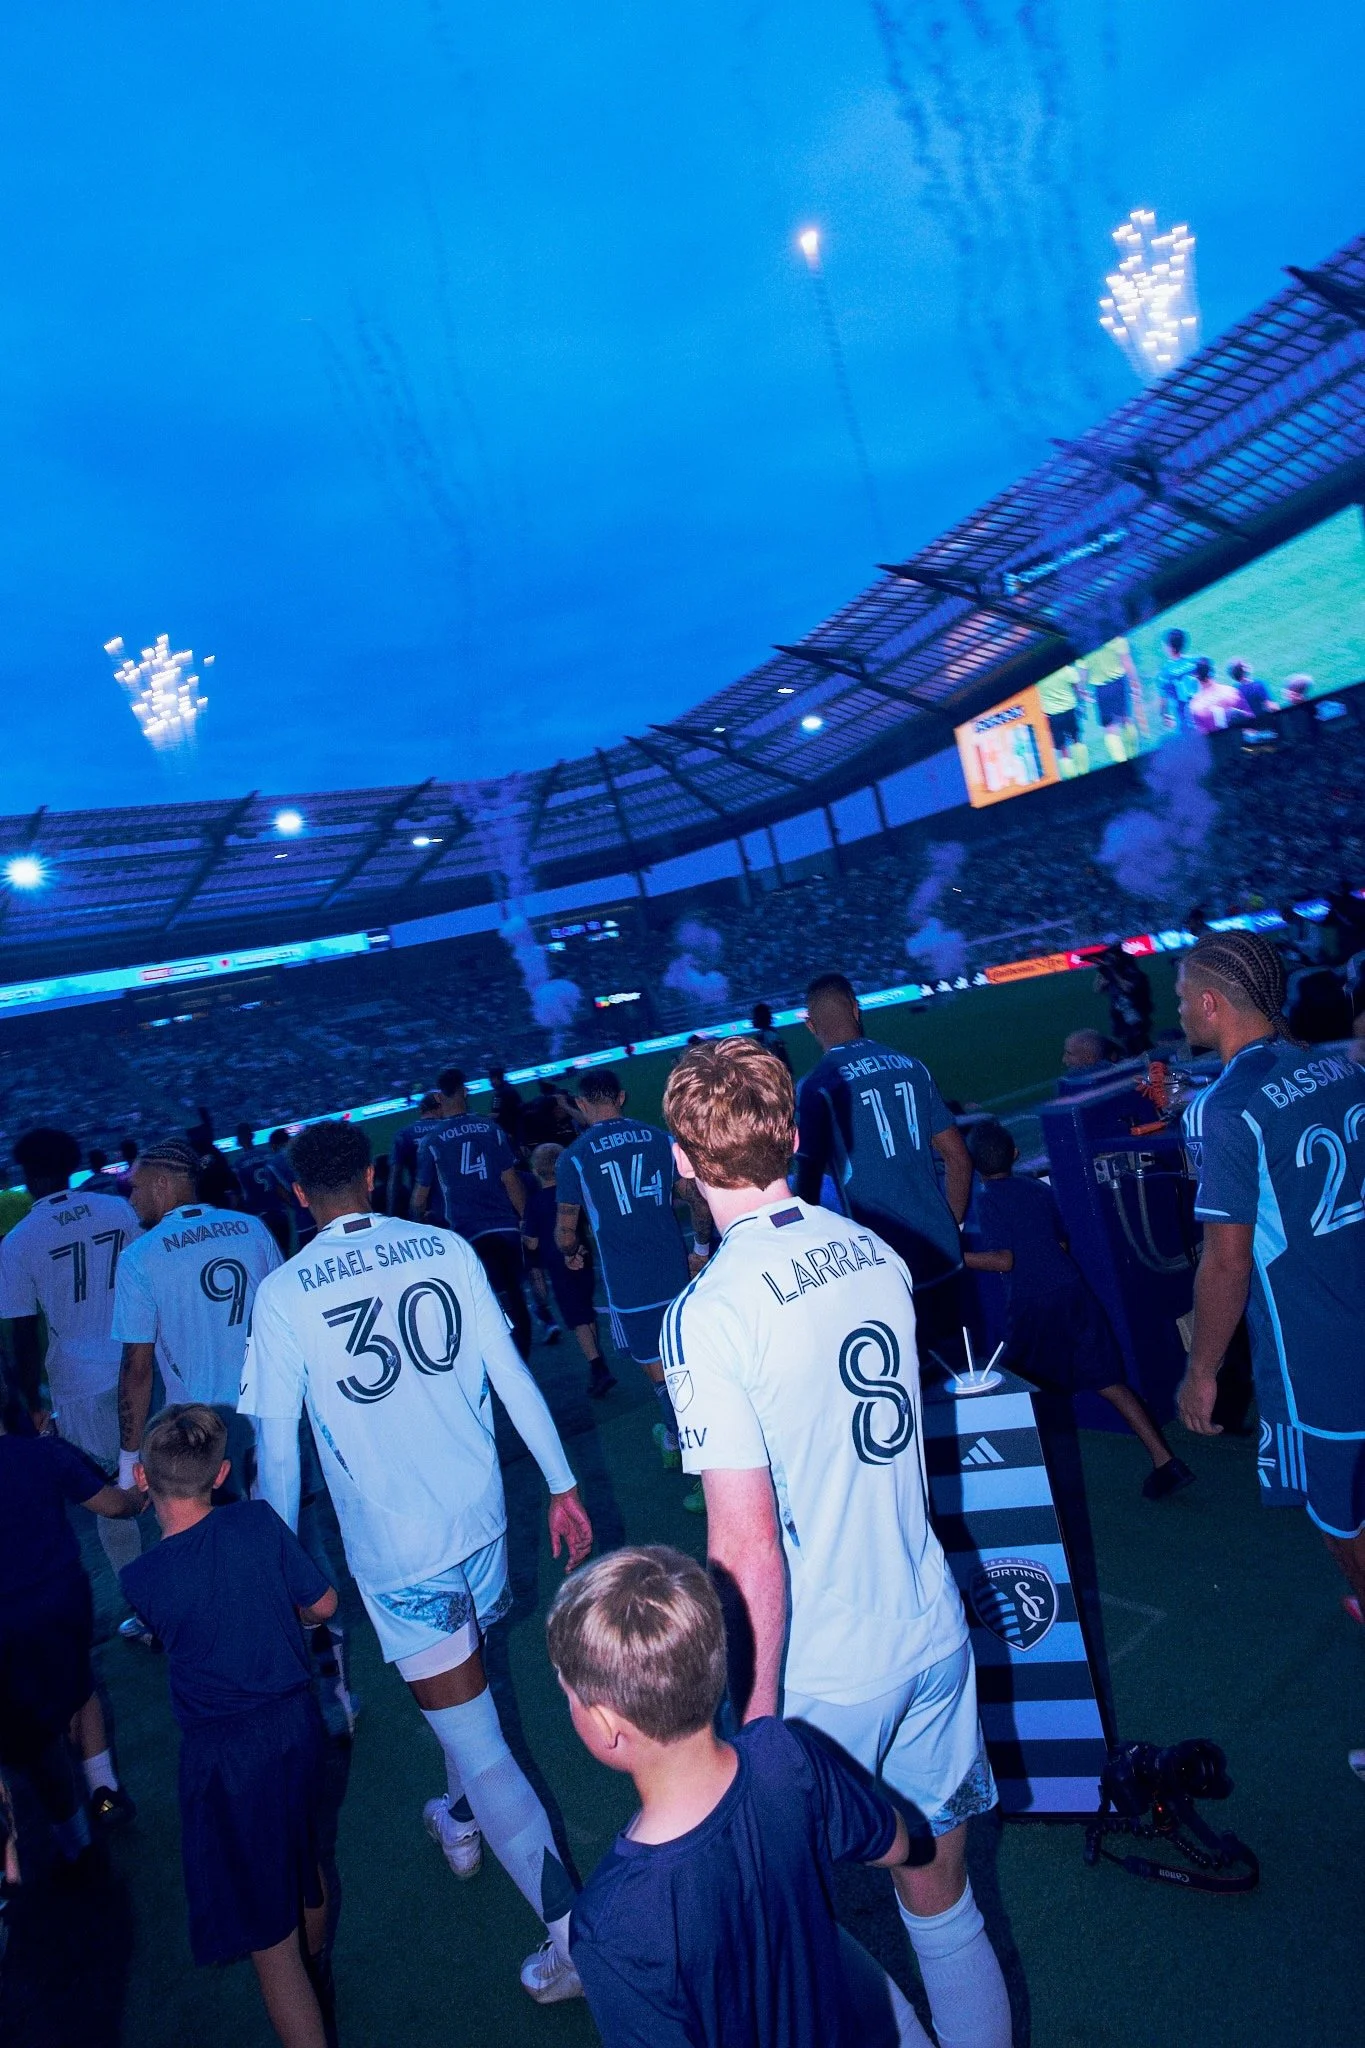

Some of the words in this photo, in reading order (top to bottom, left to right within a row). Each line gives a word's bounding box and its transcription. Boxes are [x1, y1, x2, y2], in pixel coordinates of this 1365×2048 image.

[839, 1054, 914, 1081] SHELTON
[590, 1129, 652, 1154] LEIBOLD
[860, 1081, 921, 1158] 11
[460, 1141, 488, 1180] 4
[600, 1153, 663, 1216] 14
[52, 1204, 92, 1226] YAPI
[162, 1220, 249, 1253] NAVARRO
[48, 1228, 126, 1304] 77
[200, 1256, 248, 1327] 9
[297, 1249, 373, 1292] RAFAEL
[374, 1235, 446, 1268] SANTOS
[761, 1235, 886, 1306] LARRAZ
[321, 1277, 462, 1404] 30
[838, 1319, 914, 1466] 8
[988, 1568, 1046, 1583] ORTING
[1159, 1868, 1191, 1884] Canon
